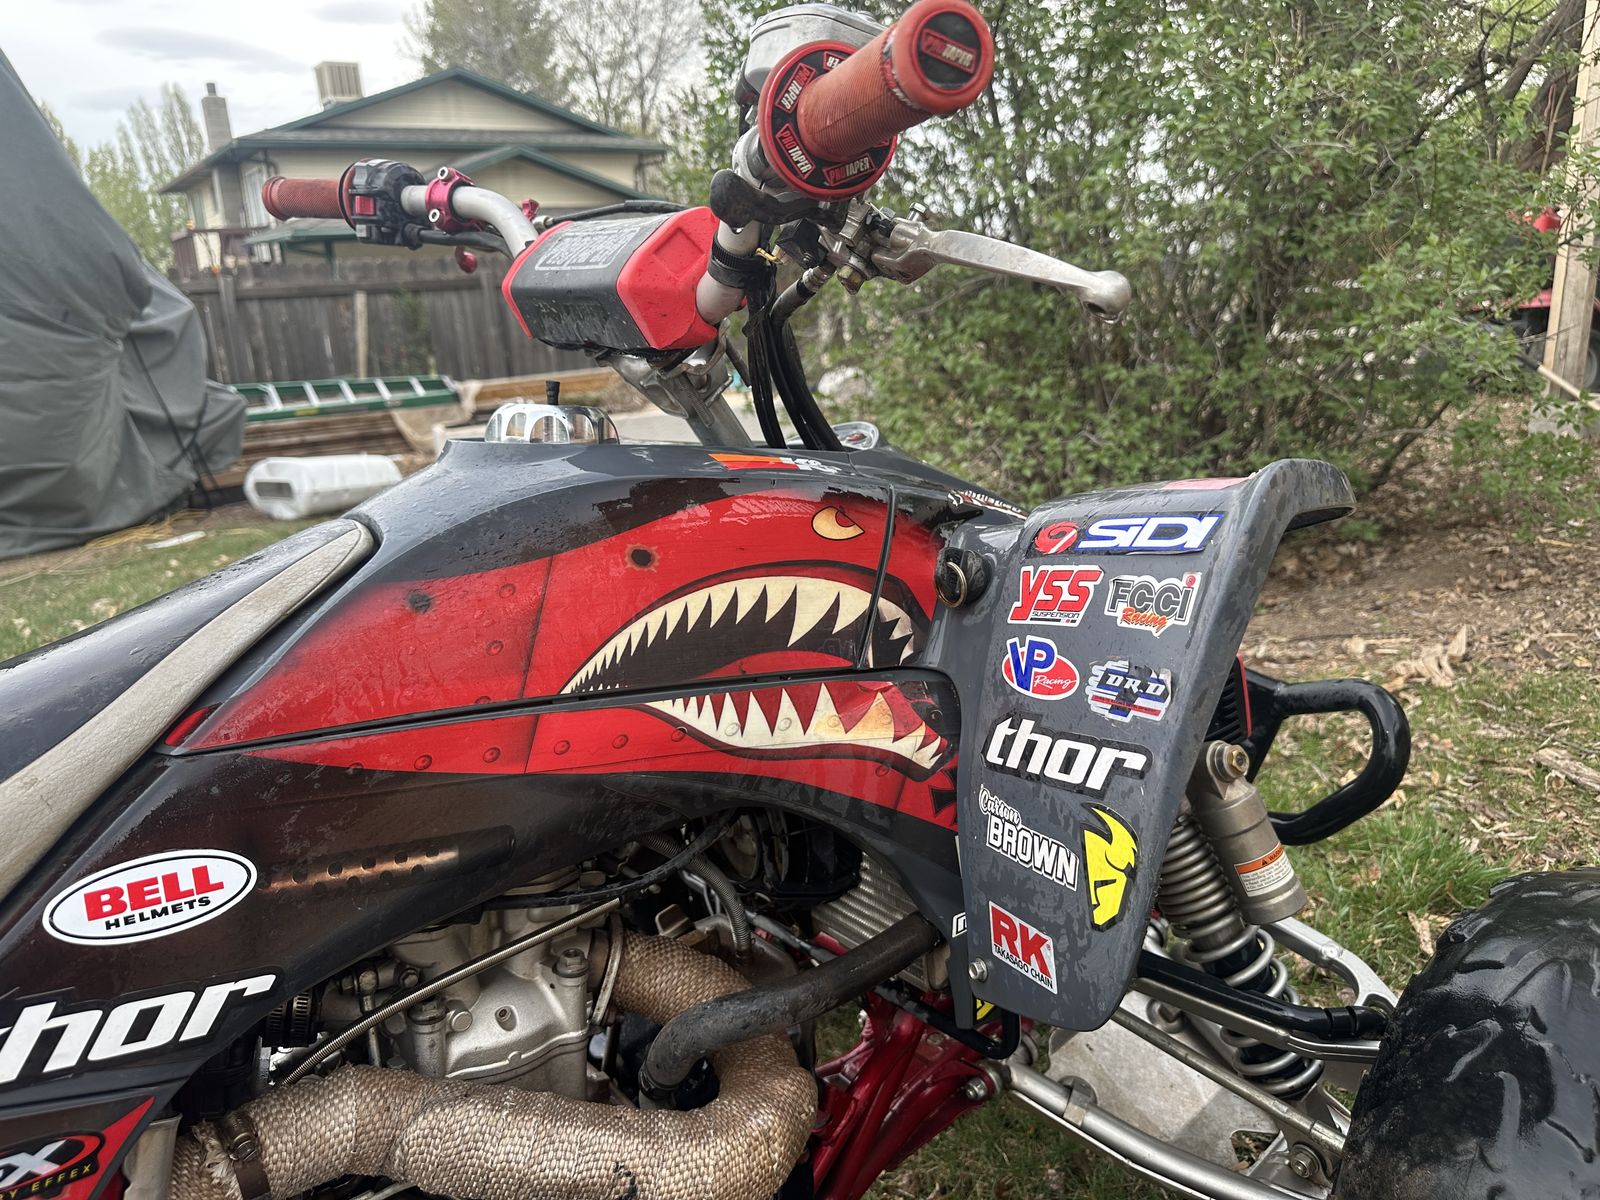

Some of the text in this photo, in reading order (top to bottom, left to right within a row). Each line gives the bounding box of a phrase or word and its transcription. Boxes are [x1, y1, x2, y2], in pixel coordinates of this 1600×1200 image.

[925, 35, 974, 67] PROTAPER
[781, 67, 810, 110] PROTAPER
[781, 130, 812, 174] PROTAPER
[829, 157, 870, 181] PROTAPER
[1077, 515, 1220, 549] SIDI
[1009, 569, 1102, 620] YSS
[1031, 610, 1080, 619] SUSPENSION
[1119, 607, 1169, 630] Racing
[1008, 638, 1056, 692] VP
[1033, 674, 1077, 690] Racing
[986, 717, 1147, 790] thor
[989, 814, 1077, 887] BROWN
[83, 865, 224, 922] BELL
[105, 896, 212, 931] HELMETS
[991, 905, 1052, 980] RK
[994, 943, 1054, 989] TAKASAGO CHAIN
[0, 974, 277, 1084] hor
[31, 1163, 93, 1192] EFFEX
